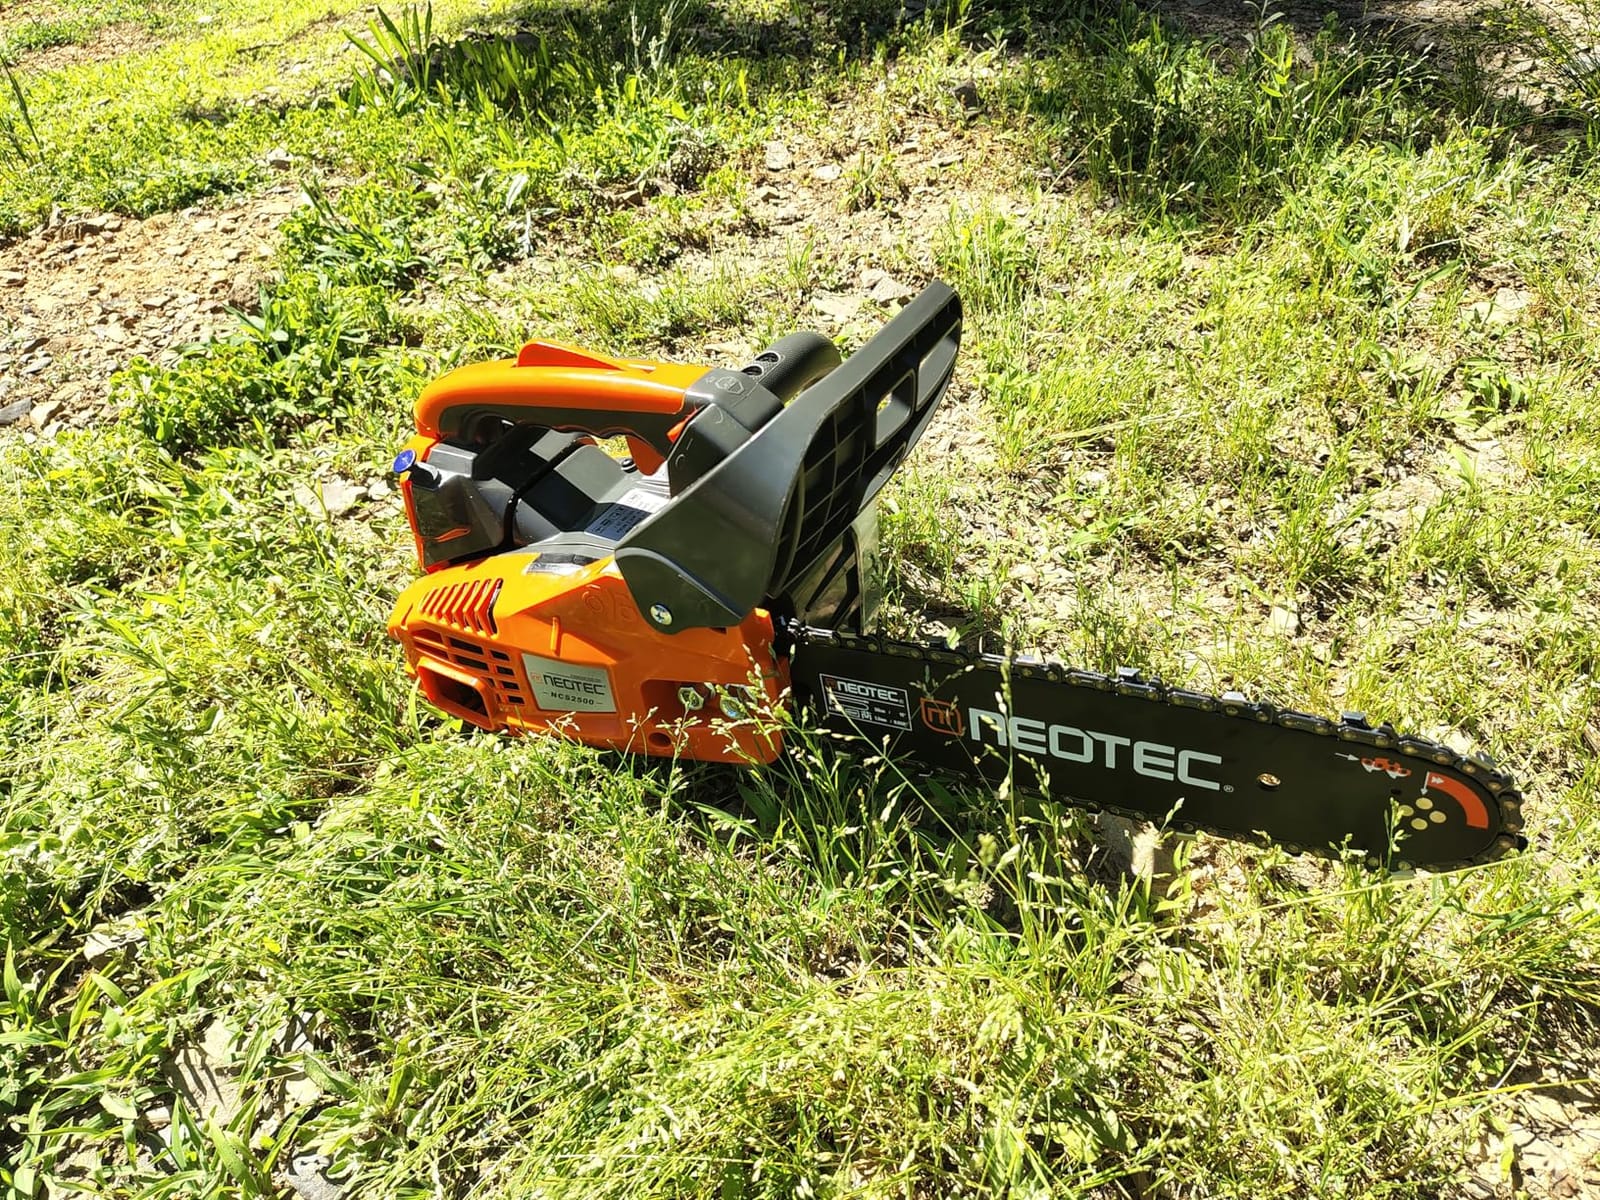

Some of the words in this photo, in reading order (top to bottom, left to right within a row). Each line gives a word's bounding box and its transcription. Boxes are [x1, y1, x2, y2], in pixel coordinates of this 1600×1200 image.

[543, 674, 605, 695] NEOTEC
[837, 681, 899, 702] NEOTEC
[550, 691, 594, 705] NCS2500
[968, 707, 1222, 791] NEOTEC
